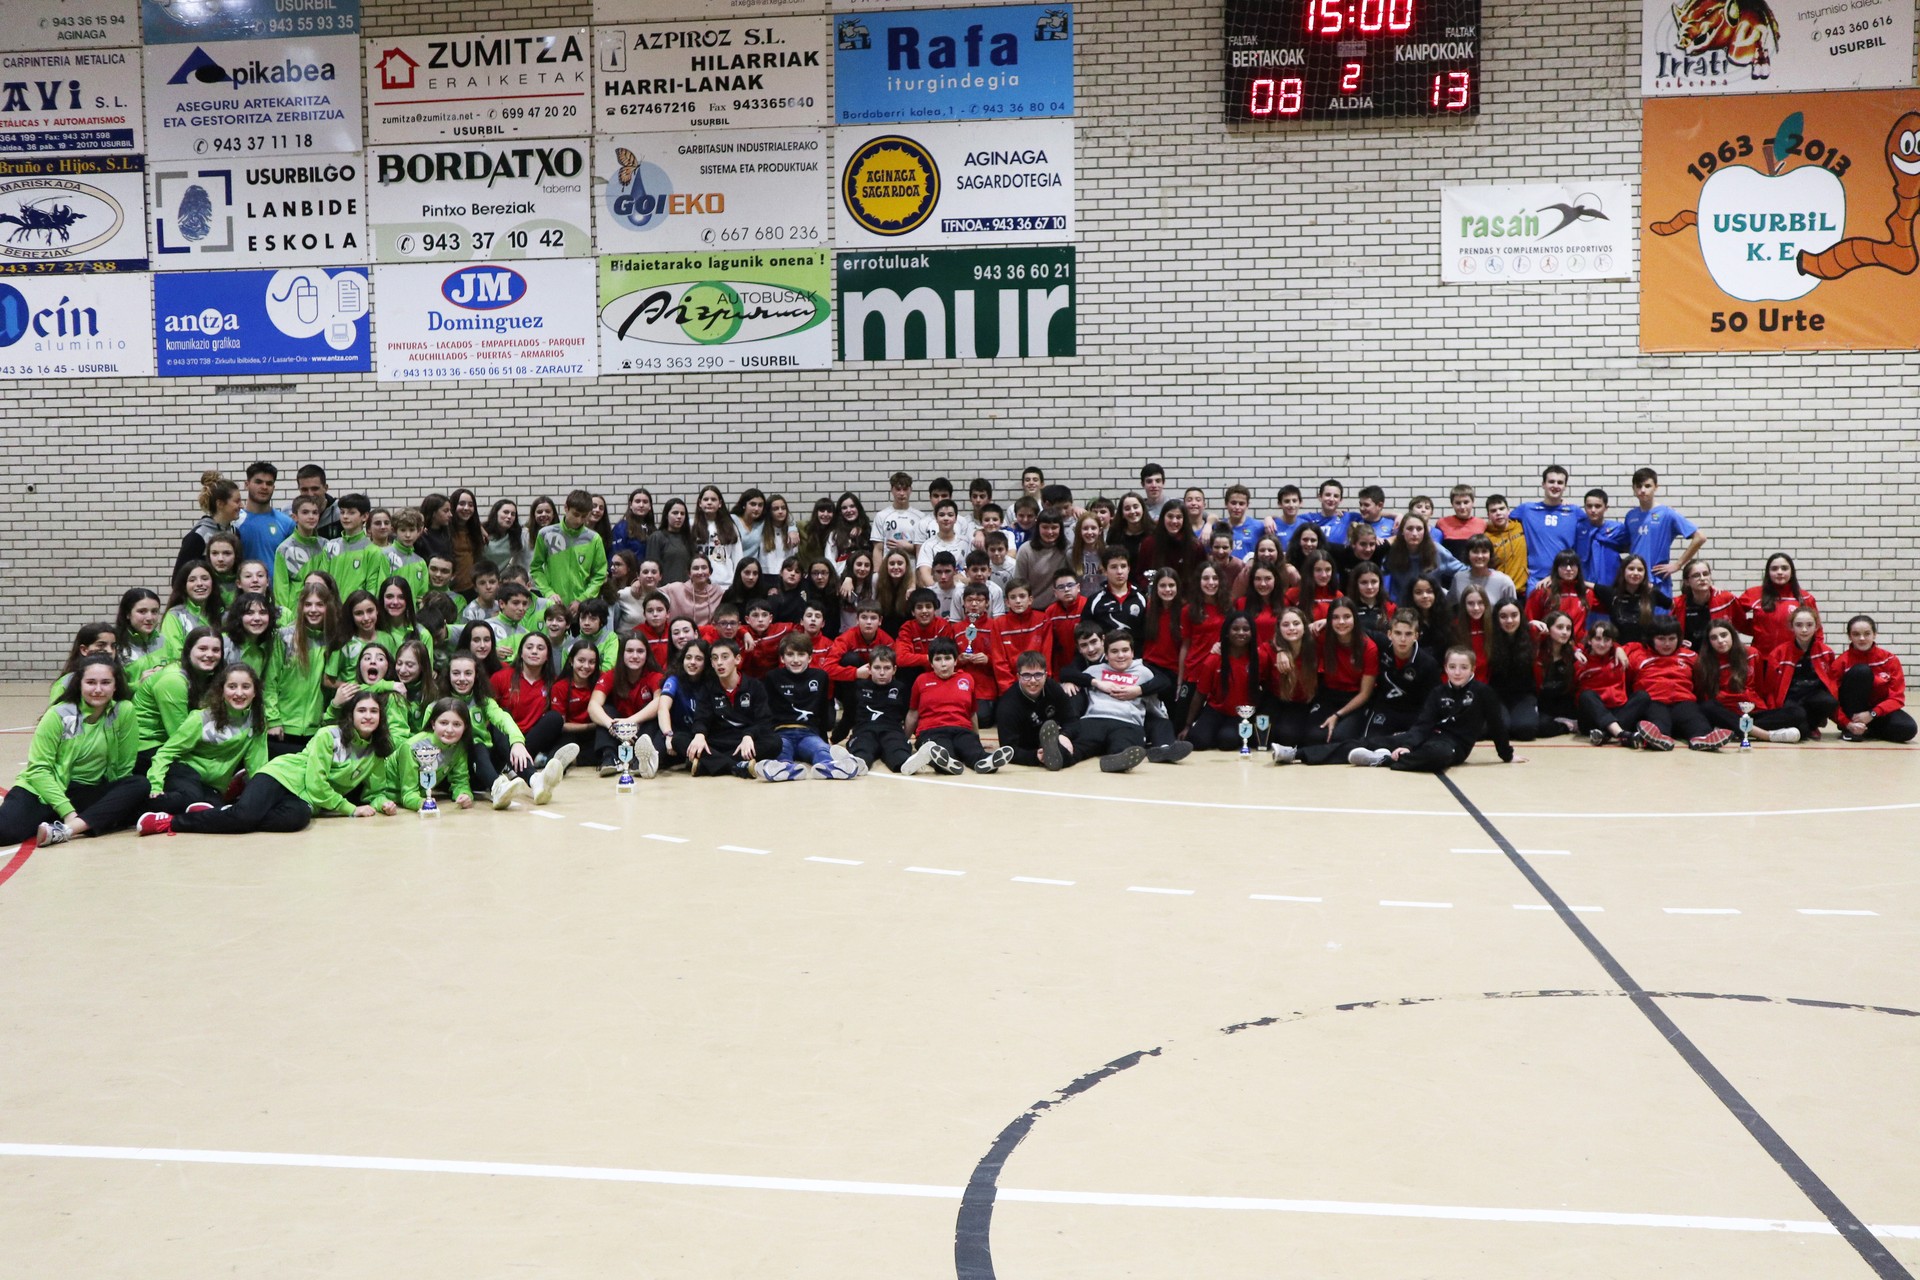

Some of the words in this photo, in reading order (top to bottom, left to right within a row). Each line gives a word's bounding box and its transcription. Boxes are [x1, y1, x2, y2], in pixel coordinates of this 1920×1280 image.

[52, 17, 75, 27] 943
[77, 16, 92, 26] 36
[110, 15, 125, 25] 94
[1307, 0, 1413, 33] 15:00
[1797, 3, 1849, 21] Intsumisio
[269, 18, 293, 32] 943
[298, 17, 312, 31] 55
[317, 16, 333, 30] 93
[338, 15, 354, 29] 35
[1446, 26, 1476, 38] FALTAK
[1825, 25, 1845, 38] 943
[1849, 20, 1869, 34] 360
[1872, 16, 1893, 28] 616
[57, 29, 107, 40] AGINAGA
[633, 29, 732, 51] AZPIROZ
[744, 28, 786, 46] S.L.
[1228, 35, 1258, 47] FALTAK
[428, 35, 584, 69] ZUMITZA
[887, 24, 1018, 71] Rafa
[1396, 42, 1474, 62] KANPOKOAK
[1829, 36, 1886, 56] USURBIL
[3, 56, 71, 68] CARPINTERIA
[75, 54, 126, 66] METALICA
[691, 50, 820, 72] HILARRIAK
[1232, 49, 1305, 68] BERTAKOAK
[232, 59, 336, 90] pikabea
[429, 71, 585, 90] ERAIKETAK
[888, 71, 1020, 93] iturgindegia
[1342, 63, 1361, 89] 2
[605, 74, 764, 96] HARRI-LANAK
[1432, 72, 1470, 108] 13
[1655, 79, 1728, 89] taberna
[176, 99, 239, 113] ASEGURU
[243, 95, 331, 110] ARTEKARITZA
[1250, 78, 1302, 114] 08
[1329, 96, 1374, 109] ALDIA
[382, 112, 474, 125] zumitza@zumitza.net
[502, 107, 524, 119] 699
[527, 106, 541, 118] 47
[545, 106, 559, 117] 20
[563, 105, 577, 116] 20
[620, 101, 696, 115] 627467216
[709, 102, 726, 112] Fax
[733, 97, 814, 110] 943365640
[842, 108, 905, 120] Bordaberri
[983, 104, 1004, 114] 943
[1009, 104, 1024, 113] 36
[1030, 103, 1045, 112] 80
[1050, 102, 1065, 111] 04
[53, 116, 126, 126] AUTOMATISMOS
[163, 117, 187, 128] ETA
[191, 114, 273, 126] GESTORITZA
[276, 109, 345, 122] ZERBITZUA
[690, 118, 730, 127] USURBIL
[453, 125, 505, 136] USURBIL
[213, 137, 242, 151] 943
[247, 136, 265, 150] 37
[272, 135, 287, 149] 11
[296, 133, 313, 147] 18
[678, 144, 734, 155] GARBITASUN
[736, 141, 819, 153] INDUSTRIALERAKO
[60, 159, 101, 174] Hijos,
[964, 149, 1049, 166] AGINAGA
[246, 164, 355, 186] USURBILGO
[377, 147, 583, 188] BORDATXO
[700, 163, 737, 175] SISTEMA
[740, 163, 755, 173] ETA
[758, 162, 818, 173] PRODUKTUAK
[542, 184, 581, 194] taberna
[957, 172, 1062, 190] SAGARDOTEGIA
[862, 184, 920, 198] SAGARDOA
[247, 199, 357, 218] LANBIDE
[422, 204, 466, 217] Pintxo
[472, 201, 536, 216] Bereziak
[613, 192, 725, 215] GOIEKO
[994, 218, 1014, 231] 943
[1017, 217, 1032, 230] 36
[1034, 217, 1049, 230] 67
[1053, 216, 1064, 229] 10
[1461, 208, 1540, 238] rasán
[248, 232, 358, 252] ESKOLA
[422, 233, 460, 251] 943
[472, 232, 495, 250] 37
[507, 230, 529, 248] 10
[539, 229, 564, 247] 42
[720, 228, 748, 241] 667
[755, 227, 784, 240] 680
[789, 226, 819, 240] 236
[4, 247, 73, 259] BEREZIAK
[1459, 247, 1494, 255] PRENDAS
[1503, 246, 1564, 254] COMPLEMENTOS
[1566, 245, 1613, 253] DEPORTIVOS
[35, 263, 56, 272] 37
[64, 262, 86, 272] 27
[92, 261, 117, 271] 88
[610, 259, 702, 272] Bidaietarako
[709, 254, 764, 271] lagunik
[770, 256, 814, 267] onena
[843, 253, 930, 270] errotuluak
[974, 265, 1001, 280] 943
[1007, 264, 1026, 279] 36
[1030, 263, 1049, 279] 60
[1054, 263, 1069, 278] 21
[450, 272, 512, 304] JM
[717, 290, 818, 305] AUTOBUSAK
[164, 309, 240, 335] antza
[427, 311, 544, 333] Dominguez
[843, 284, 1070, 361] mur
[1710, 311, 1748, 333] 50
[1759, 308, 1825, 332] Urte
[34, 339, 126, 351] aluminio
[166, 338, 210, 351] komunikazio
[387, 341, 428, 350] PINTURAS
[436, 340, 473, 349] LACADOS
[481, 338, 540, 348] EMPAPELADOS
[548, 337, 585, 346] PARQUET
[311, 354, 359, 363] www.antza.com
[408, 352, 468, 361] ACUCHILLADOS
[476, 351, 512, 360] PUERTAS
[520, 350, 565, 359] ARMARIOS
[635, 357, 662, 369] 943
[666, 357, 692, 368] 363
[697, 356, 724, 368] 290
[741, 356, 800, 367] USURBIL
[78, 364, 119, 373] USURBIL
[403, 369, 420, 377] 943
[469, 367, 486, 375] 650
[535, 364, 583, 374] ZARAUTZ
[886, 520, 897, 531] 20
[1544, 514, 1558, 527] 66
